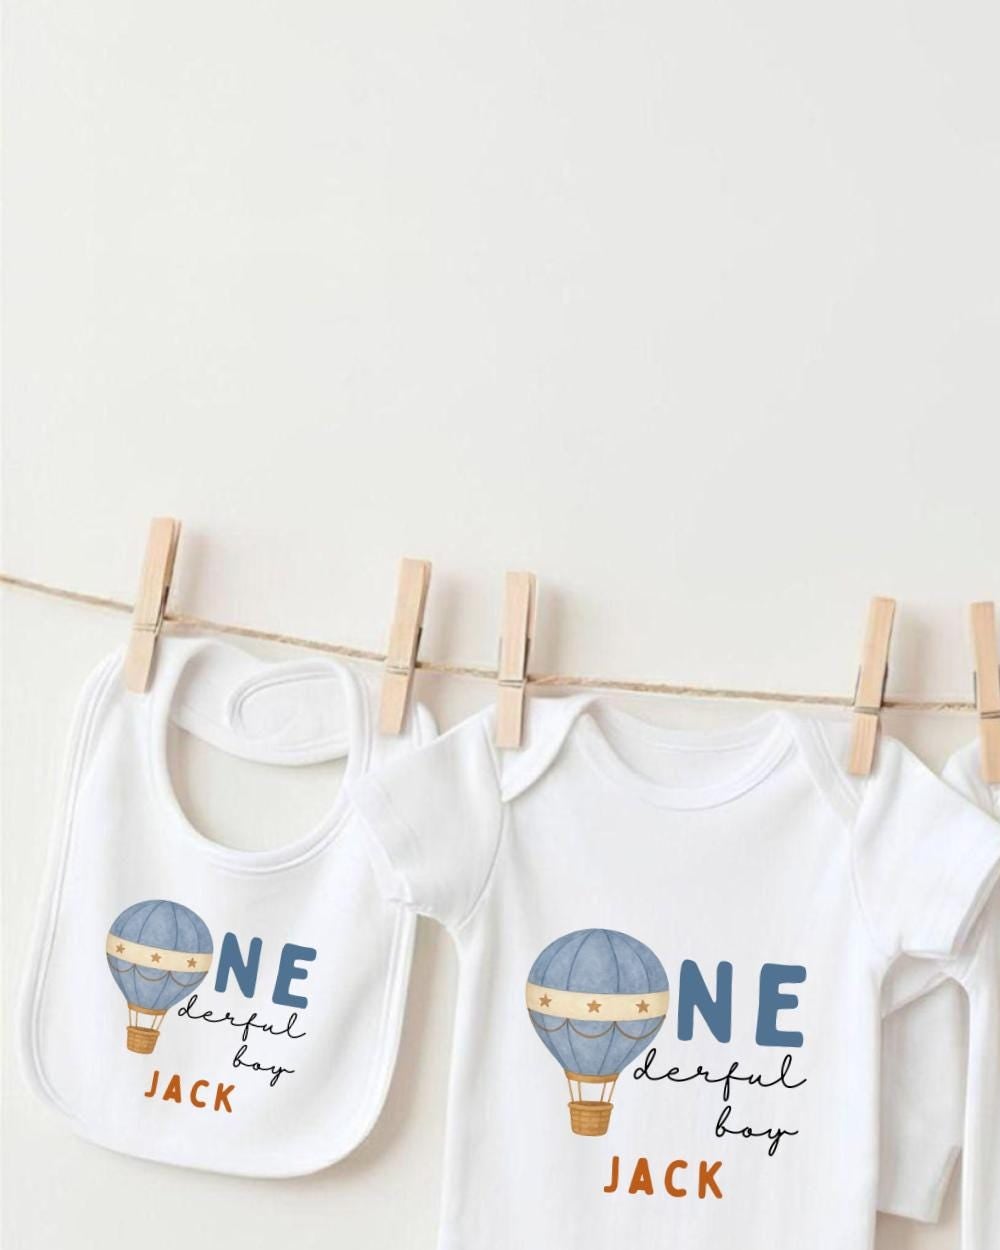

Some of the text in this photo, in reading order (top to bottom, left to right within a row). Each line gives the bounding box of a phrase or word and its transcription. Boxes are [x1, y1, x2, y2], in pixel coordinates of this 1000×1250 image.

[177, 994, 307, 1042] derful
[232, 1044, 295, 1088] boy
[633, 1047, 808, 1103] derful
[144, 1070, 235, 1113] JACK
[715, 1105, 799, 1157] boy
[603, 1155, 723, 1199] JACK
